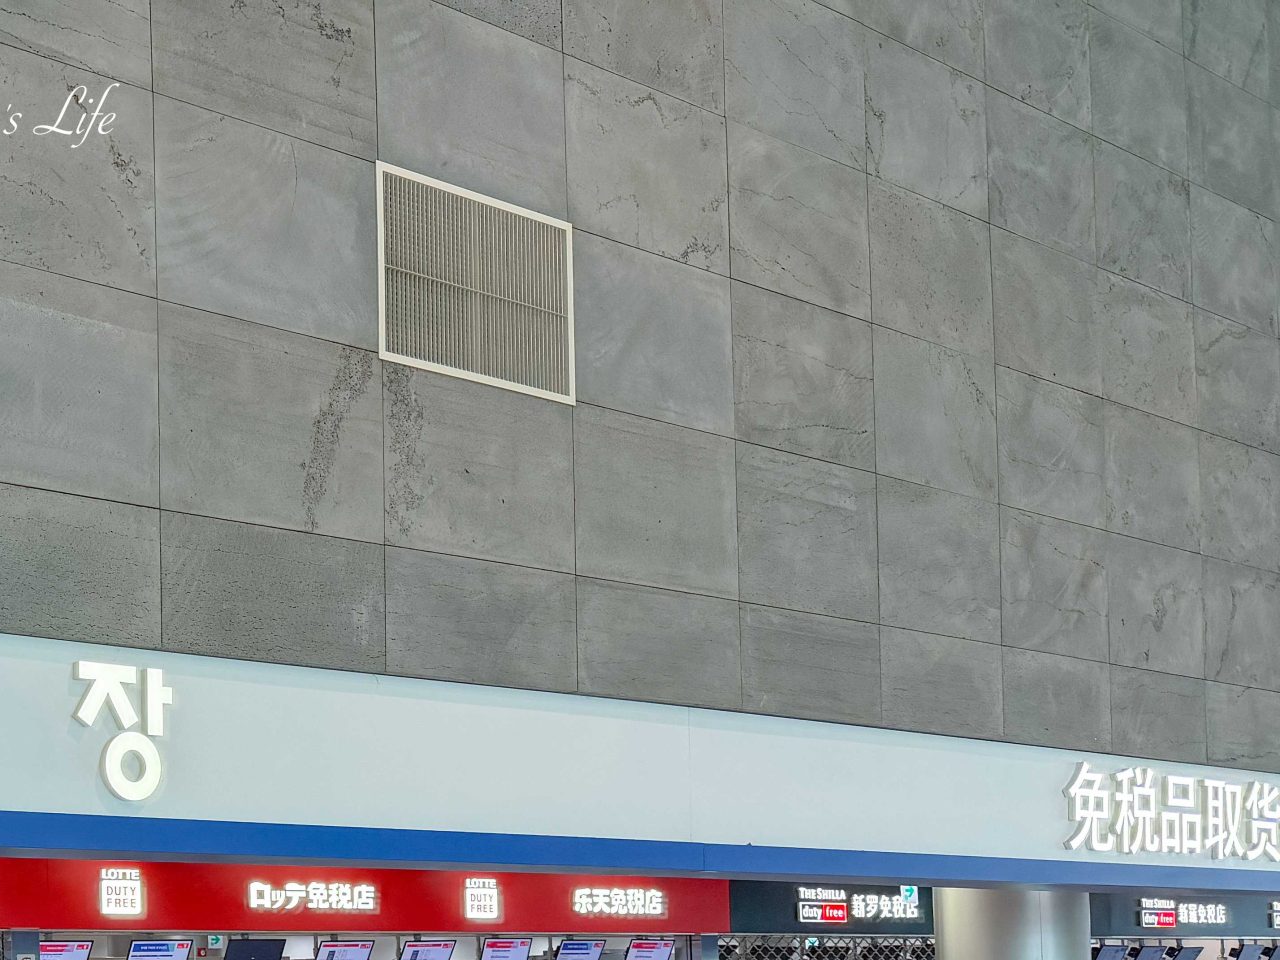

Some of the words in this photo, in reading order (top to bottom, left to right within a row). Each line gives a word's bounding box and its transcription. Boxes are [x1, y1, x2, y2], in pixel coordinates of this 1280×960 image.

[101, 869, 140, 880] LOTTE
[106, 886, 136, 896] DUTY
[249, 881, 375, 909] ロッテ免税店
[106, 898, 136, 908] FREE
[470, 894, 493, 902] DUTY
[574, 888, 663, 914] 乐天免税店
[470, 904, 493, 912] FREE
[802, 905, 822, 920] duty
[825, 905, 844, 917] free
[1144, 913, 1158, 925] duty
[1160, 914, 1173, 923] free
